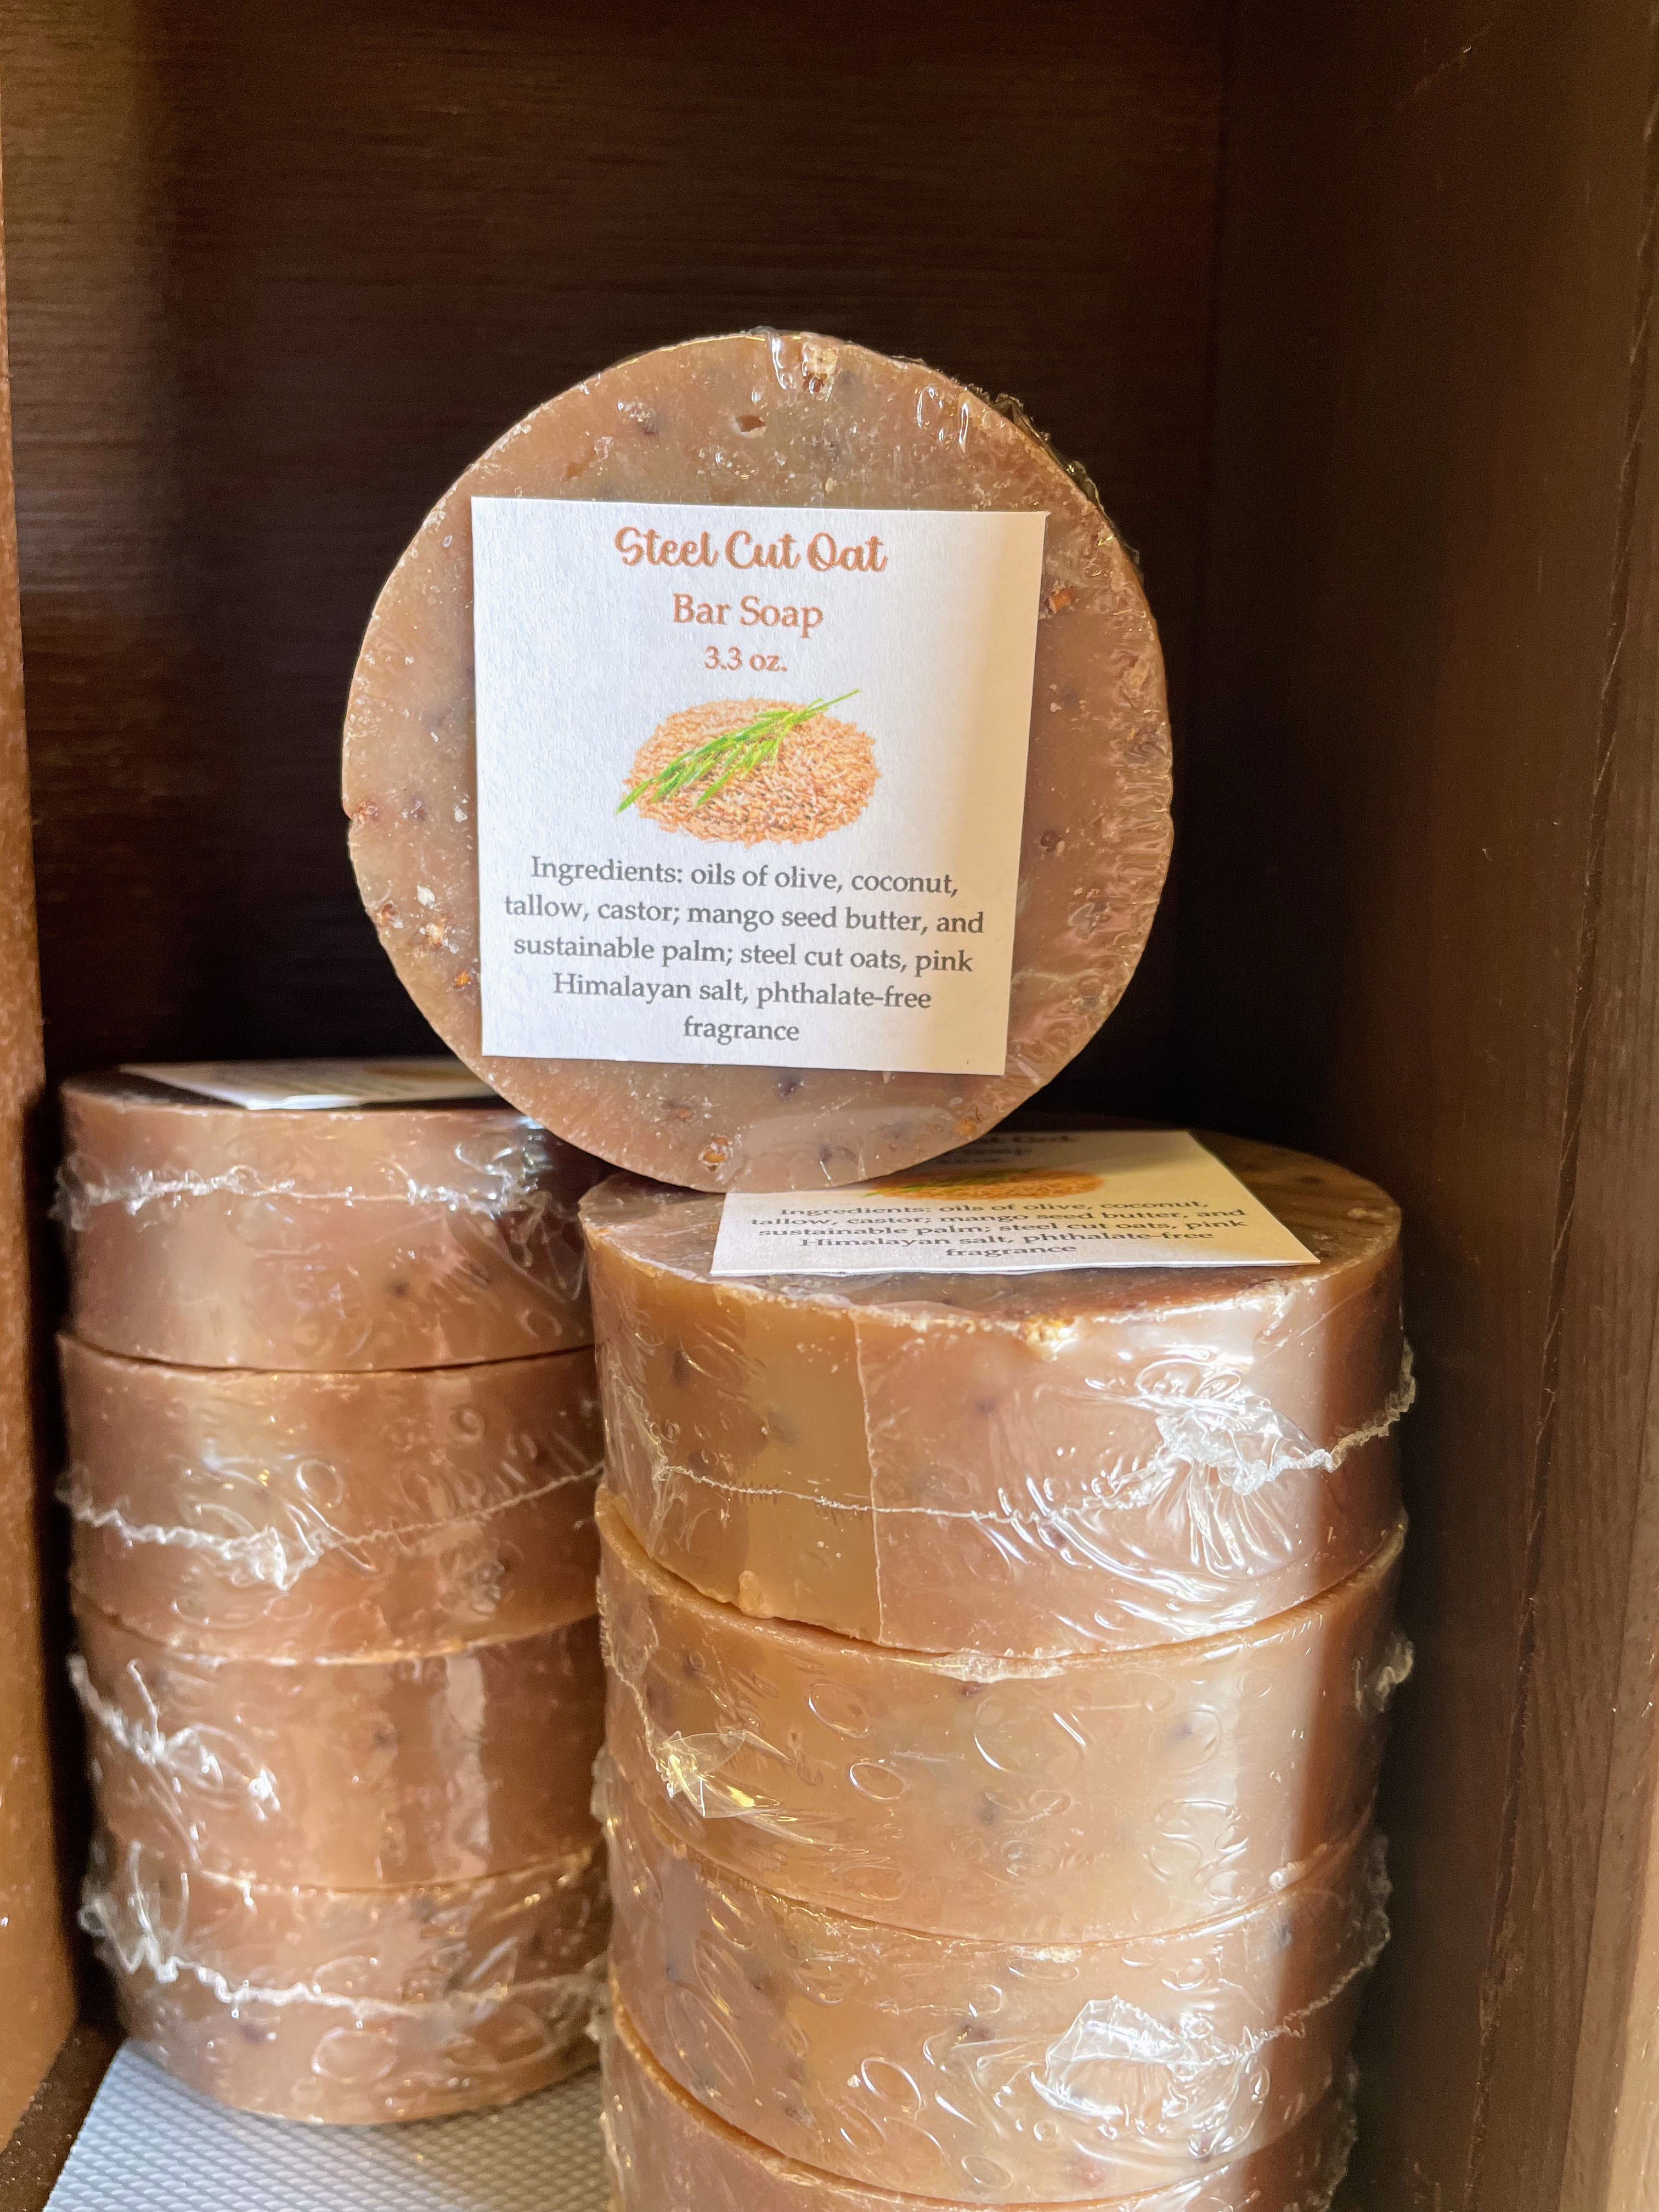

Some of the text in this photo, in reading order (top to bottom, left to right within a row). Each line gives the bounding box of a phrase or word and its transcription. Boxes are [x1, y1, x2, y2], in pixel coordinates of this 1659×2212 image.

[615, 527, 887, 572] Steel Cut Oat
[673, 592, 824, 639] Bar Soap
[704, 645, 788, 672] 3.3 oz.
[531, 855, 958, 898] Ingredients: oils of olive, coconut,
[505, 893, 984, 935] tallow, castor; mango seed butter, and
[514, 935, 973, 978] sustainable palm; steel cut oats, pink
[553, 972, 932, 1009] Himalayan salt, phthalate-free
[684, 1014, 799, 1045] fragrance
[751, 1217, 839, 1226] tallow,
[939, 1214, 1030, 1223] mango
[1196, 1209, 1246, 1218] and
[780, 1206, 930, 1217] Ingredients:
[938, 1204, 984, 1212] oils
[1099, 1200, 1209, 1209] coconut,
[758, 1226, 909, 1237] sustainable
[916, 1225, 991, 1237] palm;
[998, 1222, 1059, 1232] steel
[1184, 1220, 1248, 1231] pink
[800, 1231, 1215, 1248] Himalayan salt, phthalate-free
[945, 1245, 1077, 1258] fragrance
